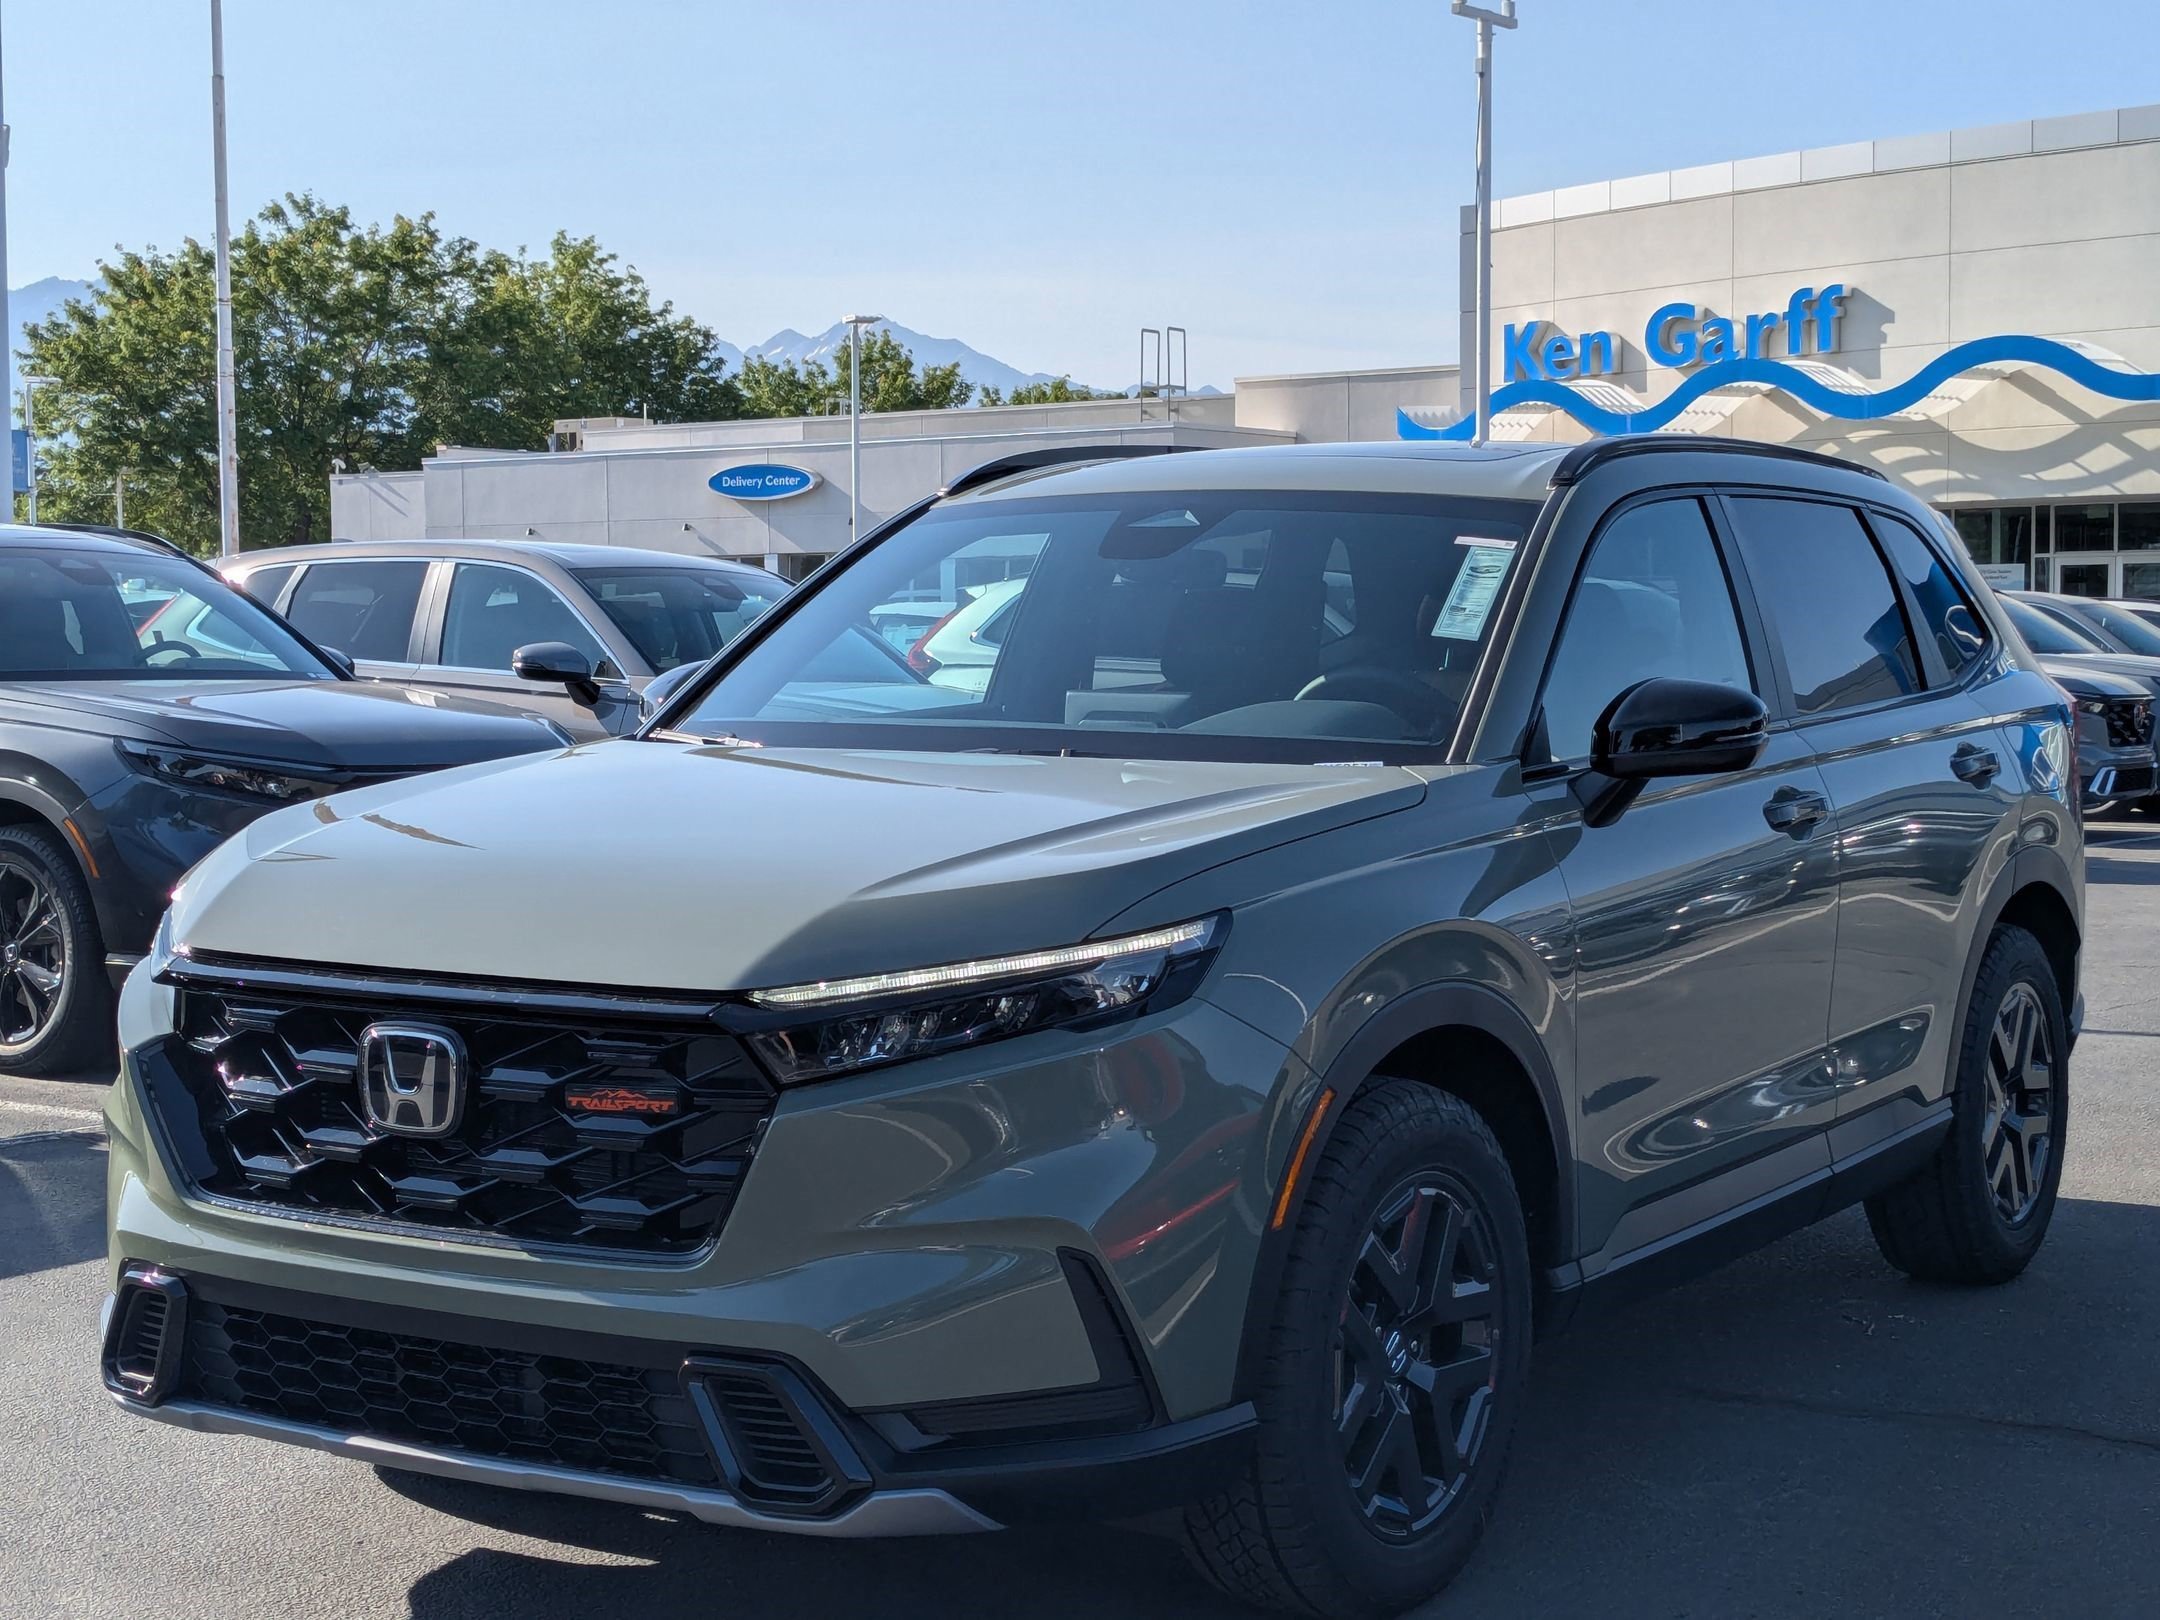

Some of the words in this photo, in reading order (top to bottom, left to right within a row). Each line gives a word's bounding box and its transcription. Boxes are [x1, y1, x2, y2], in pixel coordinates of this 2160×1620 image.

[1503, 320, 1615, 383] Ken
[1644, 283, 1846, 368] Garff
[722, 476, 763, 489] Delivery
[765, 474, 801, 487] Center
[567, 1096, 675, 1113] TRAILSPORT
